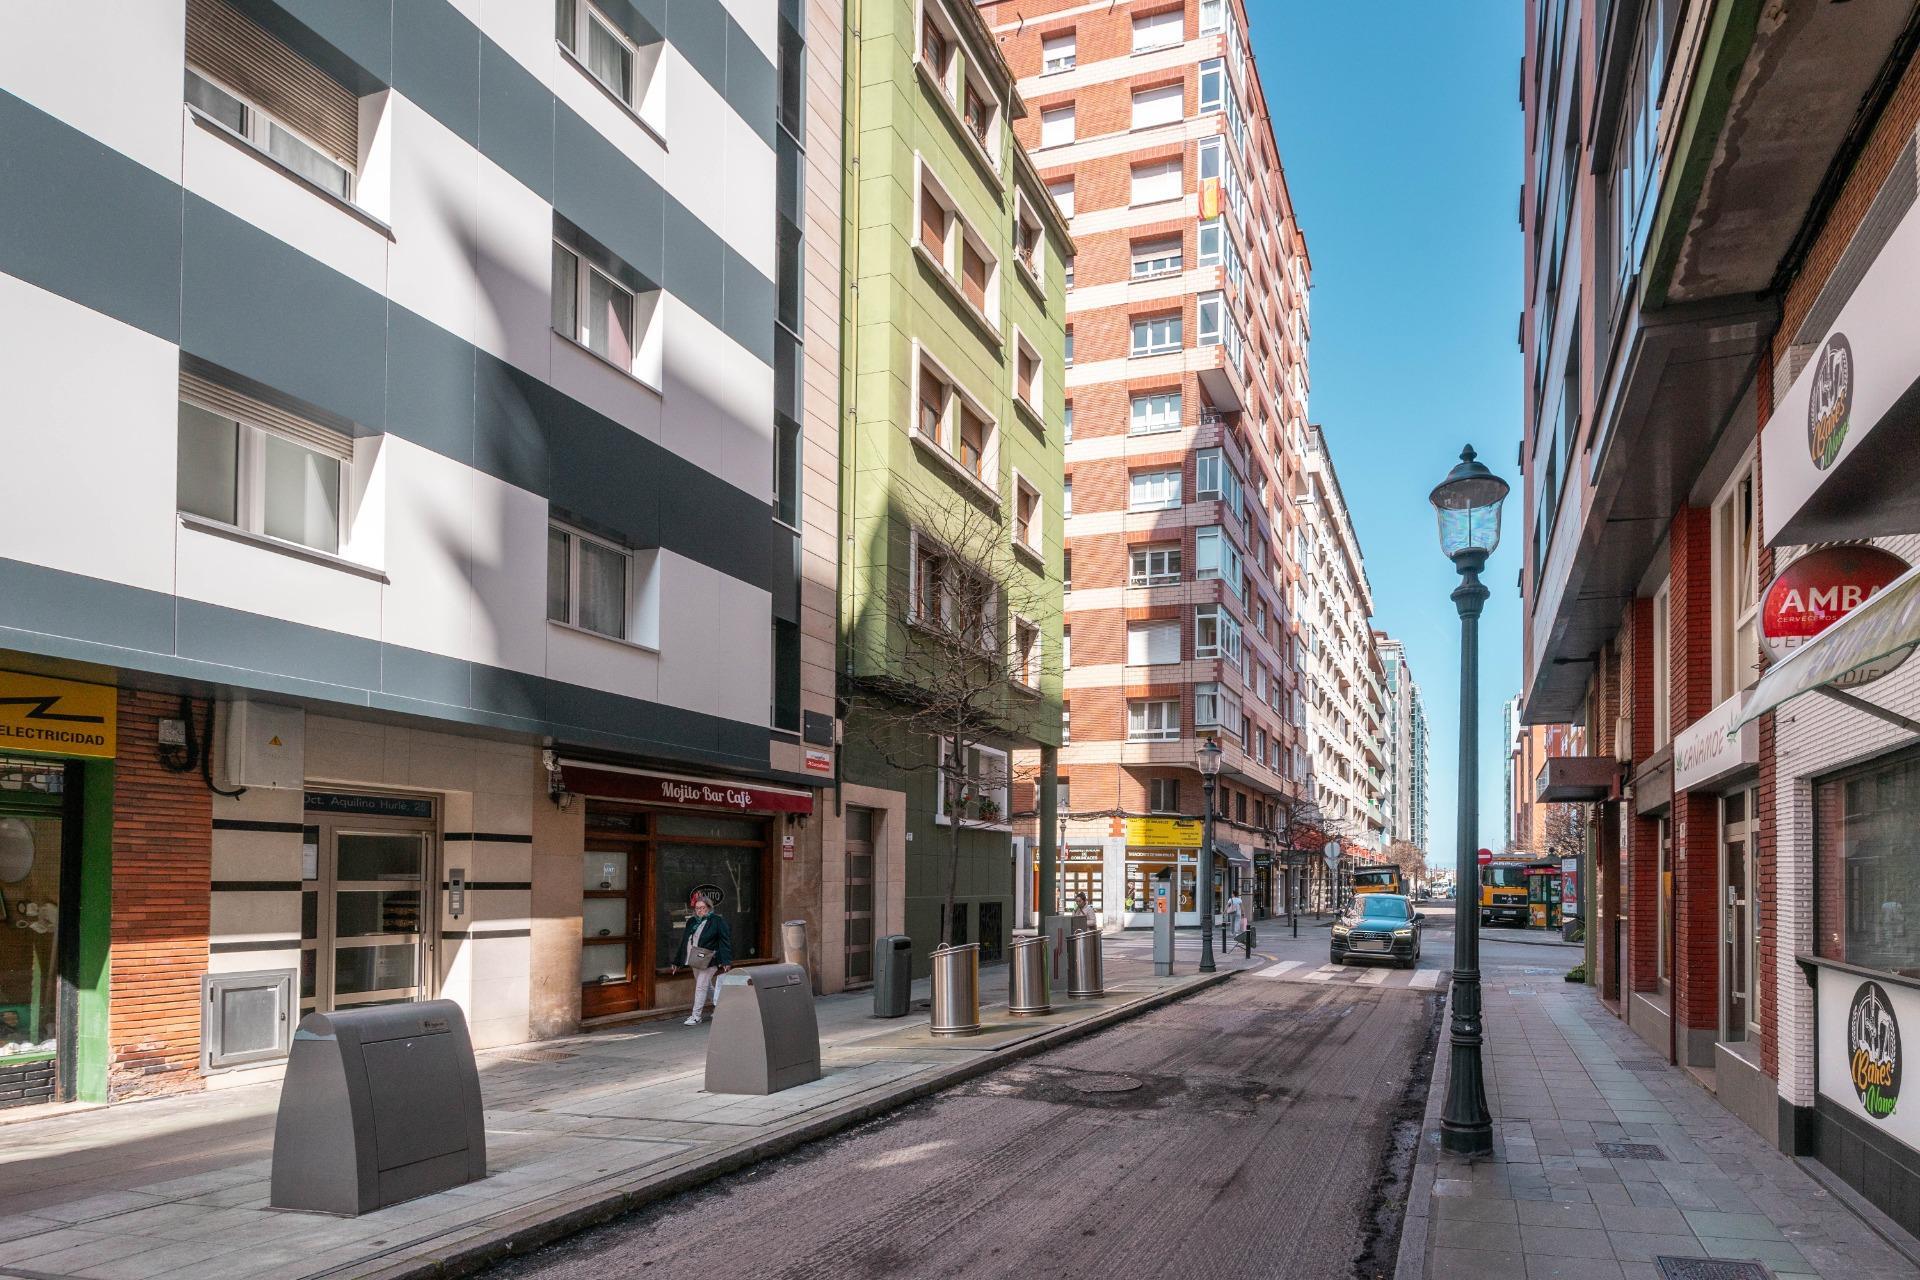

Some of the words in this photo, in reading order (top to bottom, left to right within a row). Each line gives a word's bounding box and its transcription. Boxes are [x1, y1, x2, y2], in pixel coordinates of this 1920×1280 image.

[330, 797, 371, 809] Aquilino
[661, 781, 702, 803] Mojito
[702, 786, 725, 802] Bar
[726, 789, 752, 808] Café
